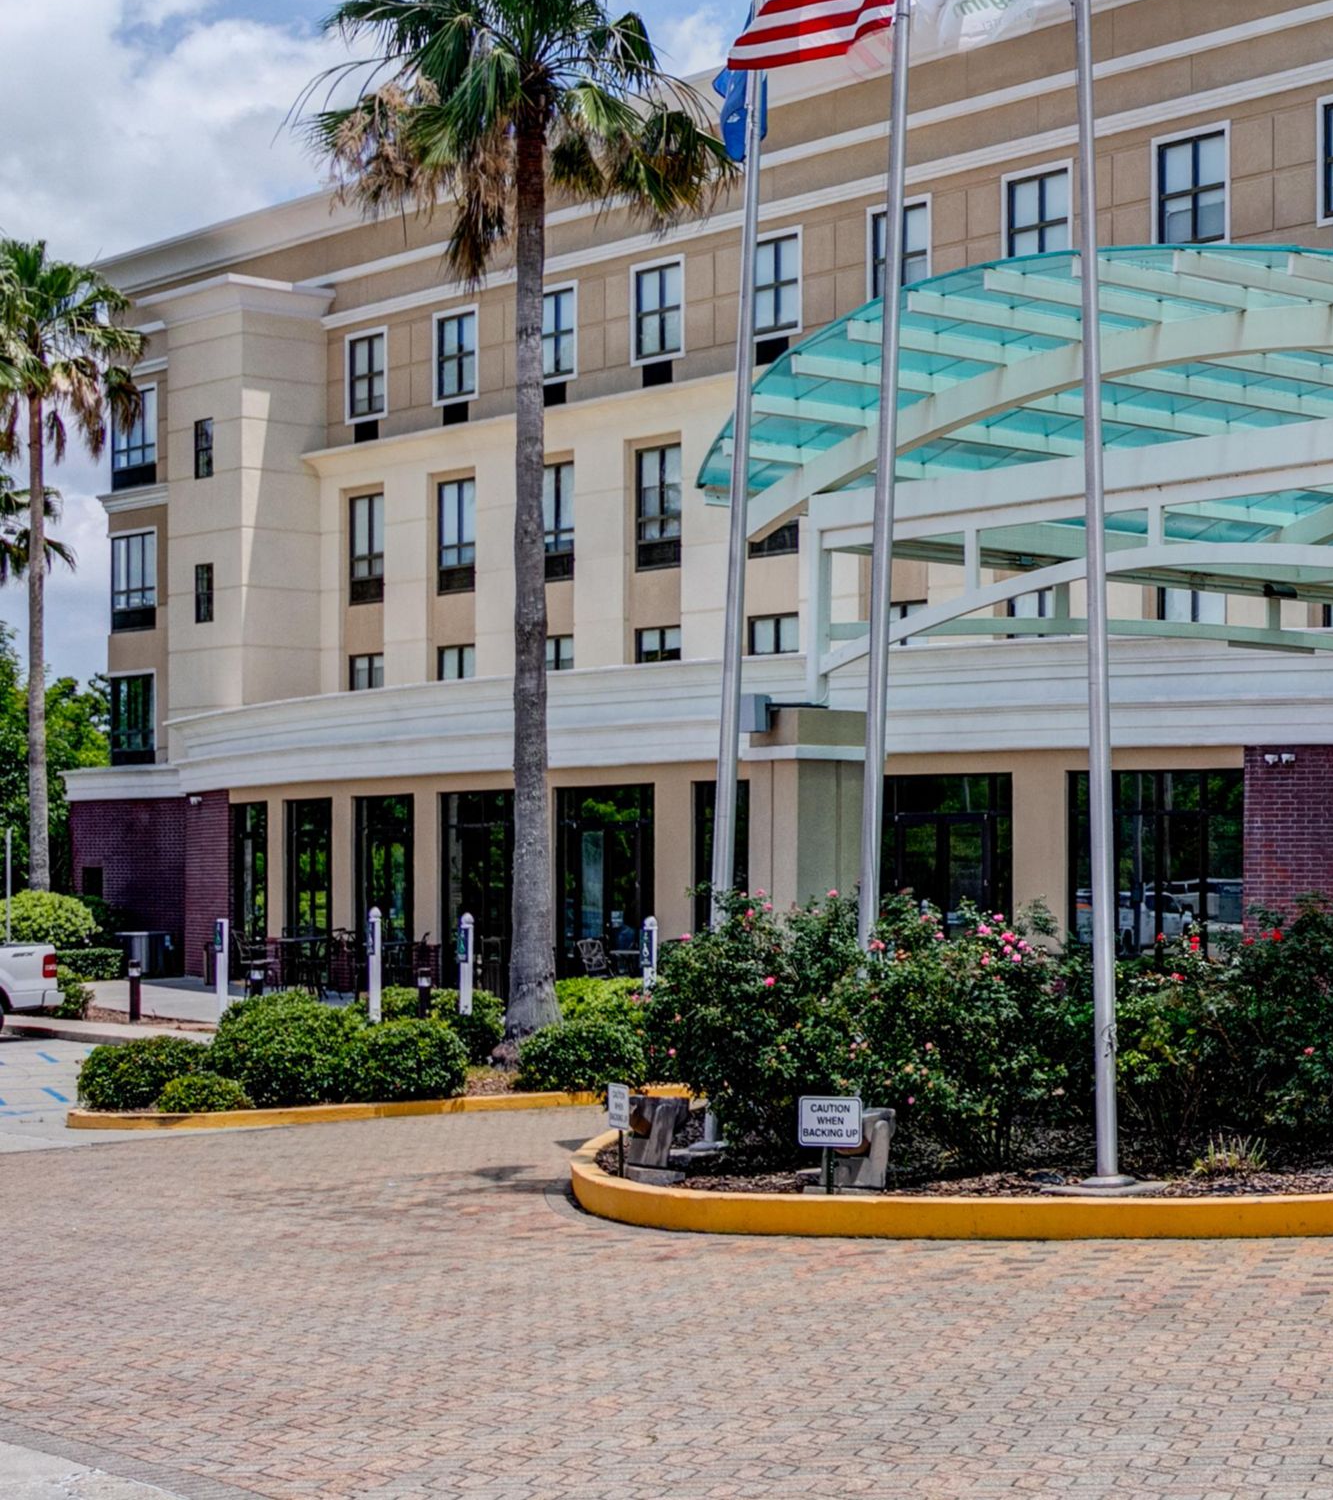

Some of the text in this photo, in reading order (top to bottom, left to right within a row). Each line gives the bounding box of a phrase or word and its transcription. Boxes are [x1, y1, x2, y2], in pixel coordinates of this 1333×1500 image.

[810, 1103, 850, 1113] CAUTION
[816, 1116, 844, 1125] WHEN
[803, 1128, 858, 1138] BACKING UP
